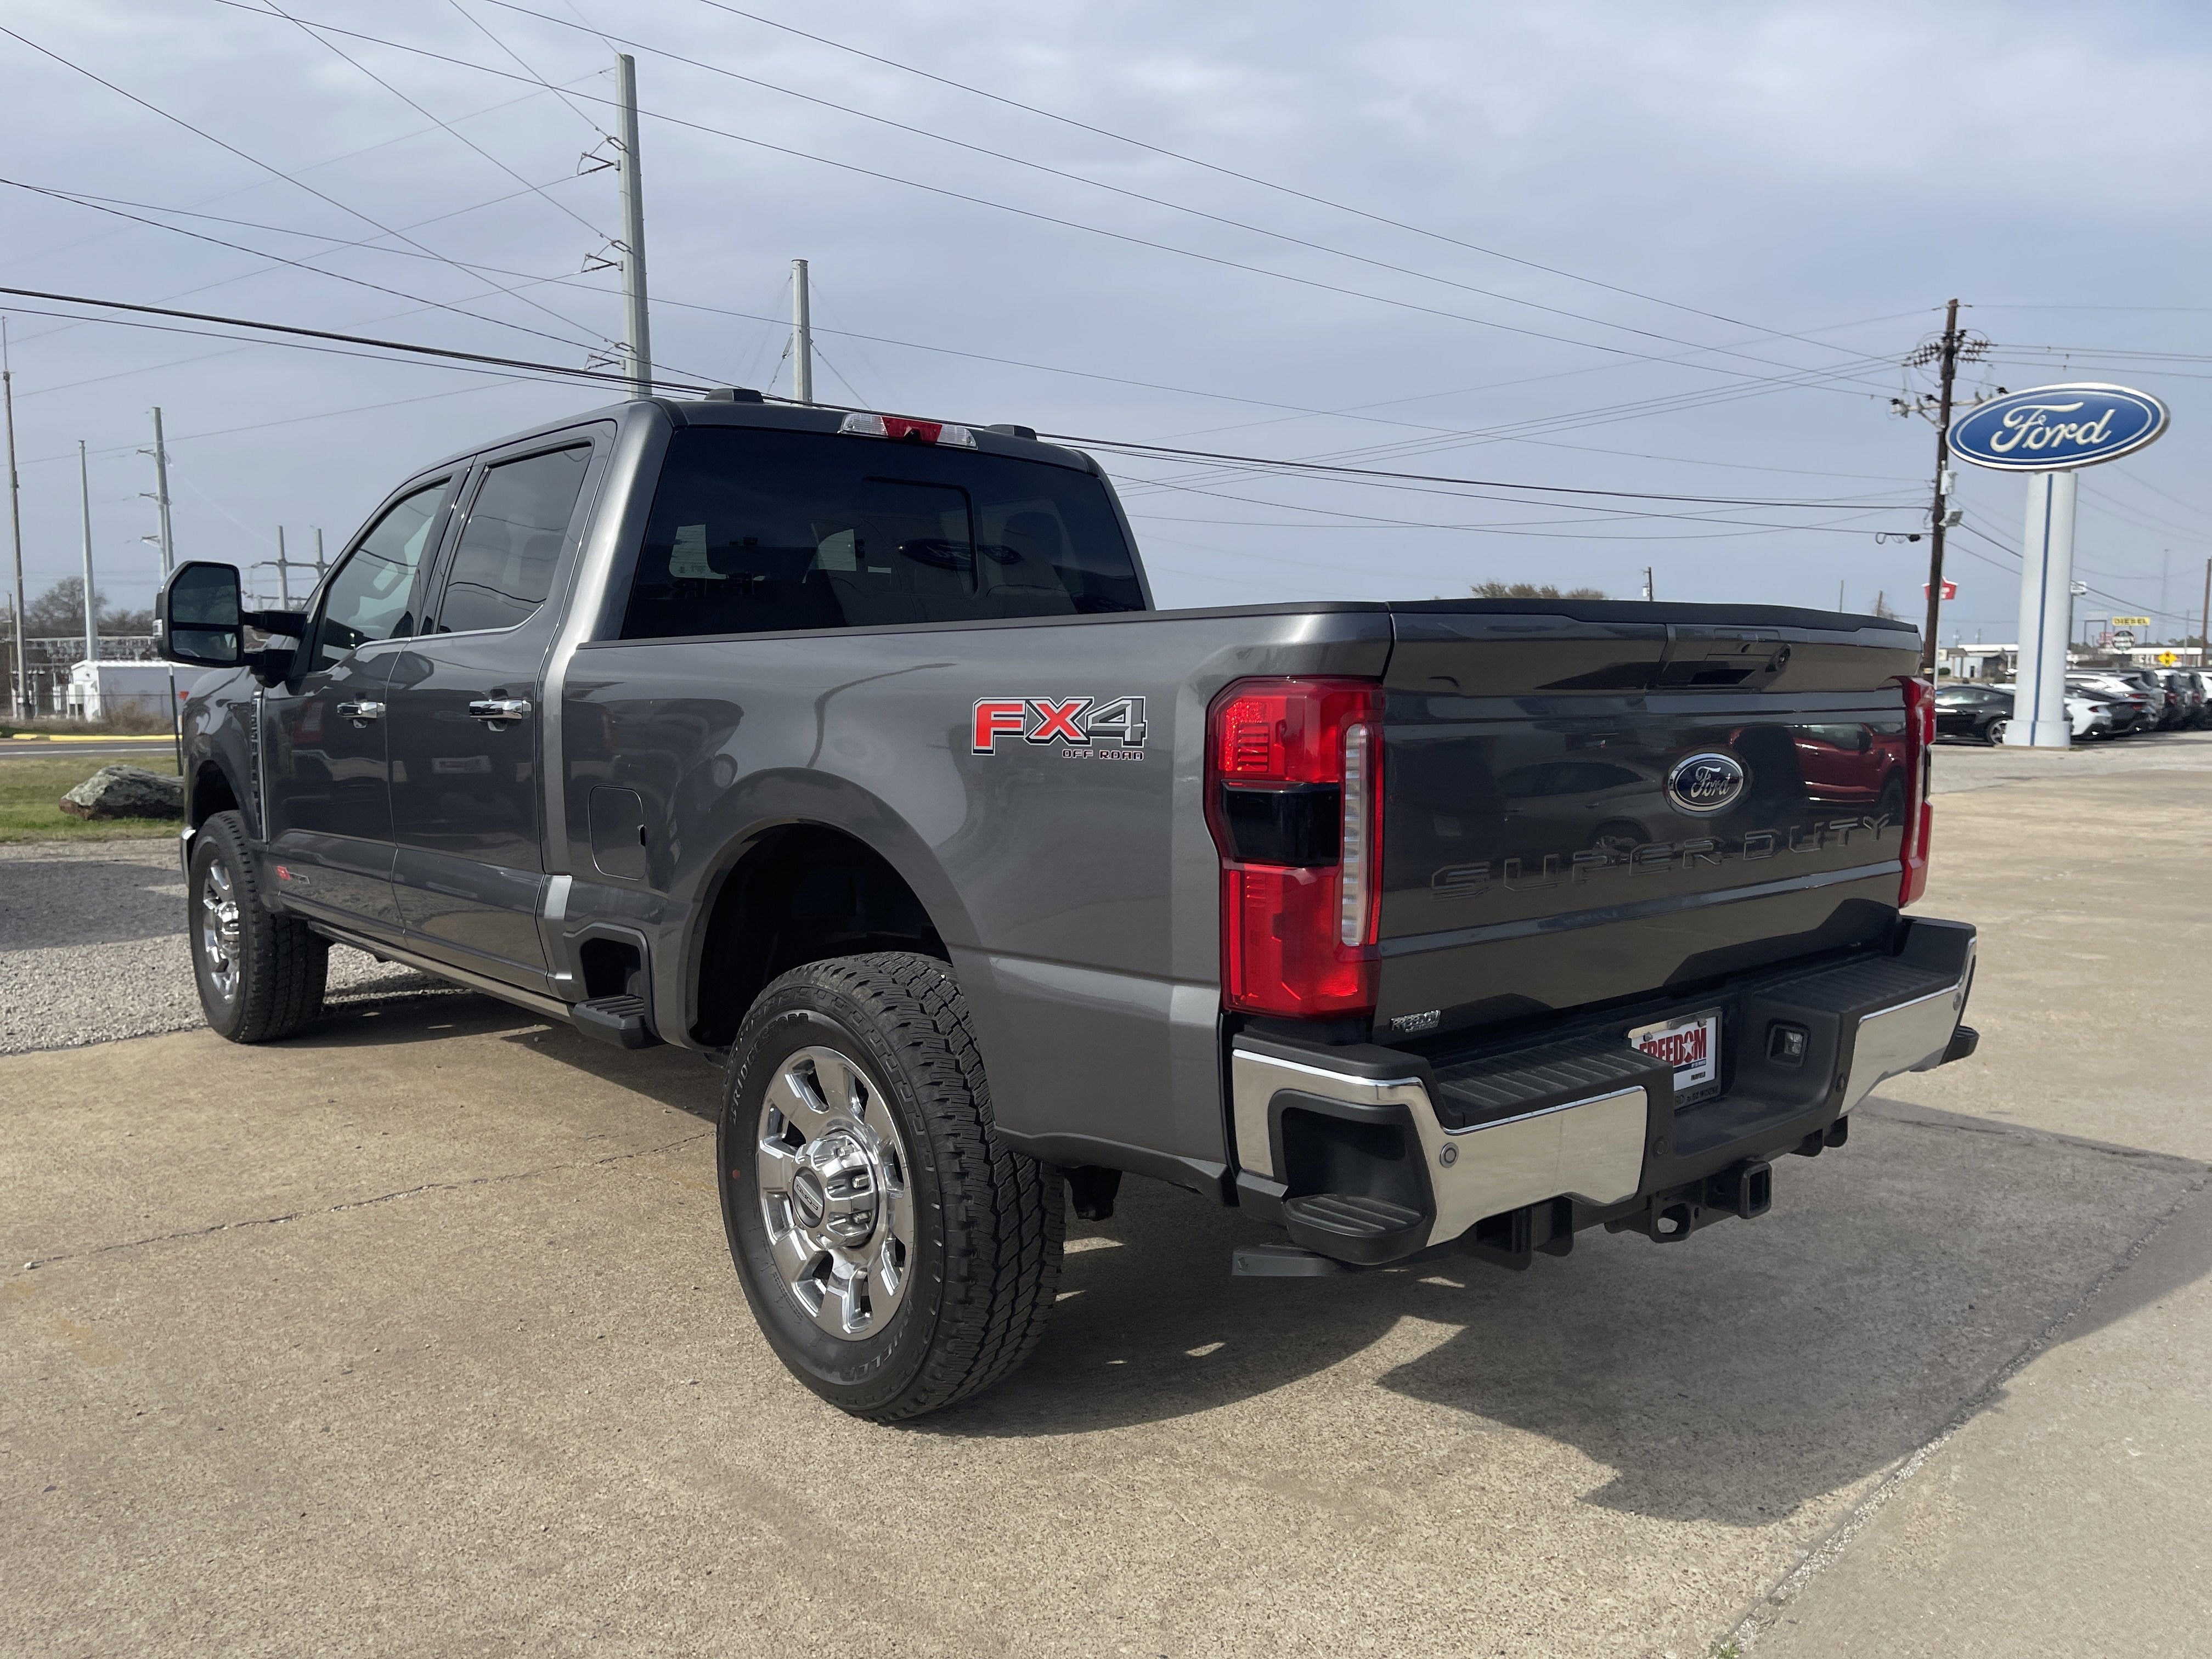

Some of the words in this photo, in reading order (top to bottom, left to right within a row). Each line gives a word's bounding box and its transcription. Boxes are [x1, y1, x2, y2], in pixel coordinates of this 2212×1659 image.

[1990, 401, 2116, 453] Ford
[972, 696, 1148, 755] FX4
[1062, 748, 1093, 759] OFF
[1099, 749, 1144, 761] ROAD
[1691, 766, 1730, 798] Ford
[1431, 836, 1731, 902] SUPER
[1743, 813, 1890, 860] DUTY
[797, 1184, 818, 1210] FORD
